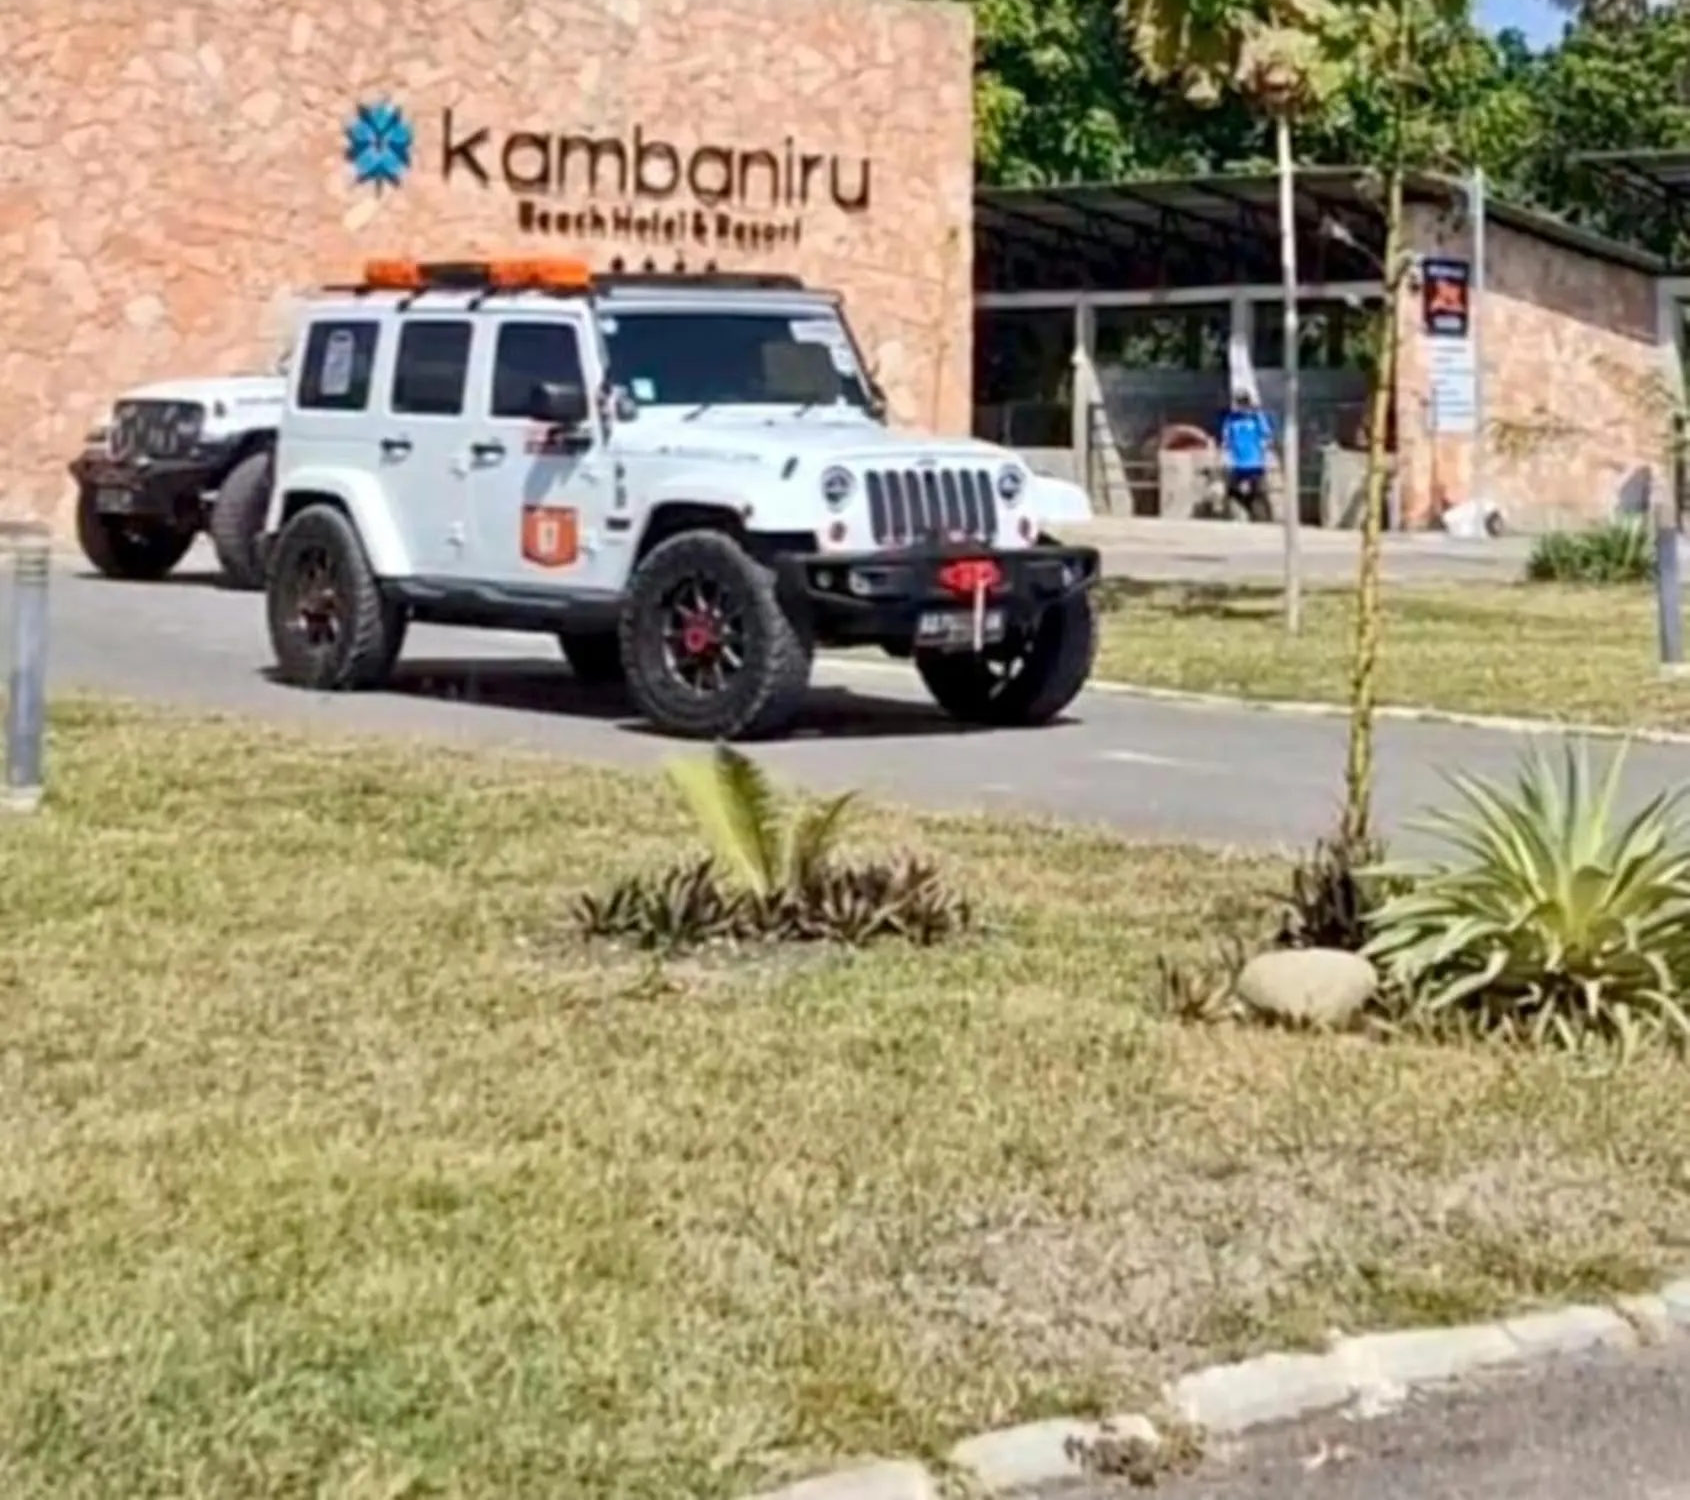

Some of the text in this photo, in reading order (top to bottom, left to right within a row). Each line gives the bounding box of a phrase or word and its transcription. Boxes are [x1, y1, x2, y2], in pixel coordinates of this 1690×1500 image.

[442, 107, 871, 212] kambaniru
[518, 199, 802, 248] Beach Hotel & Resort
